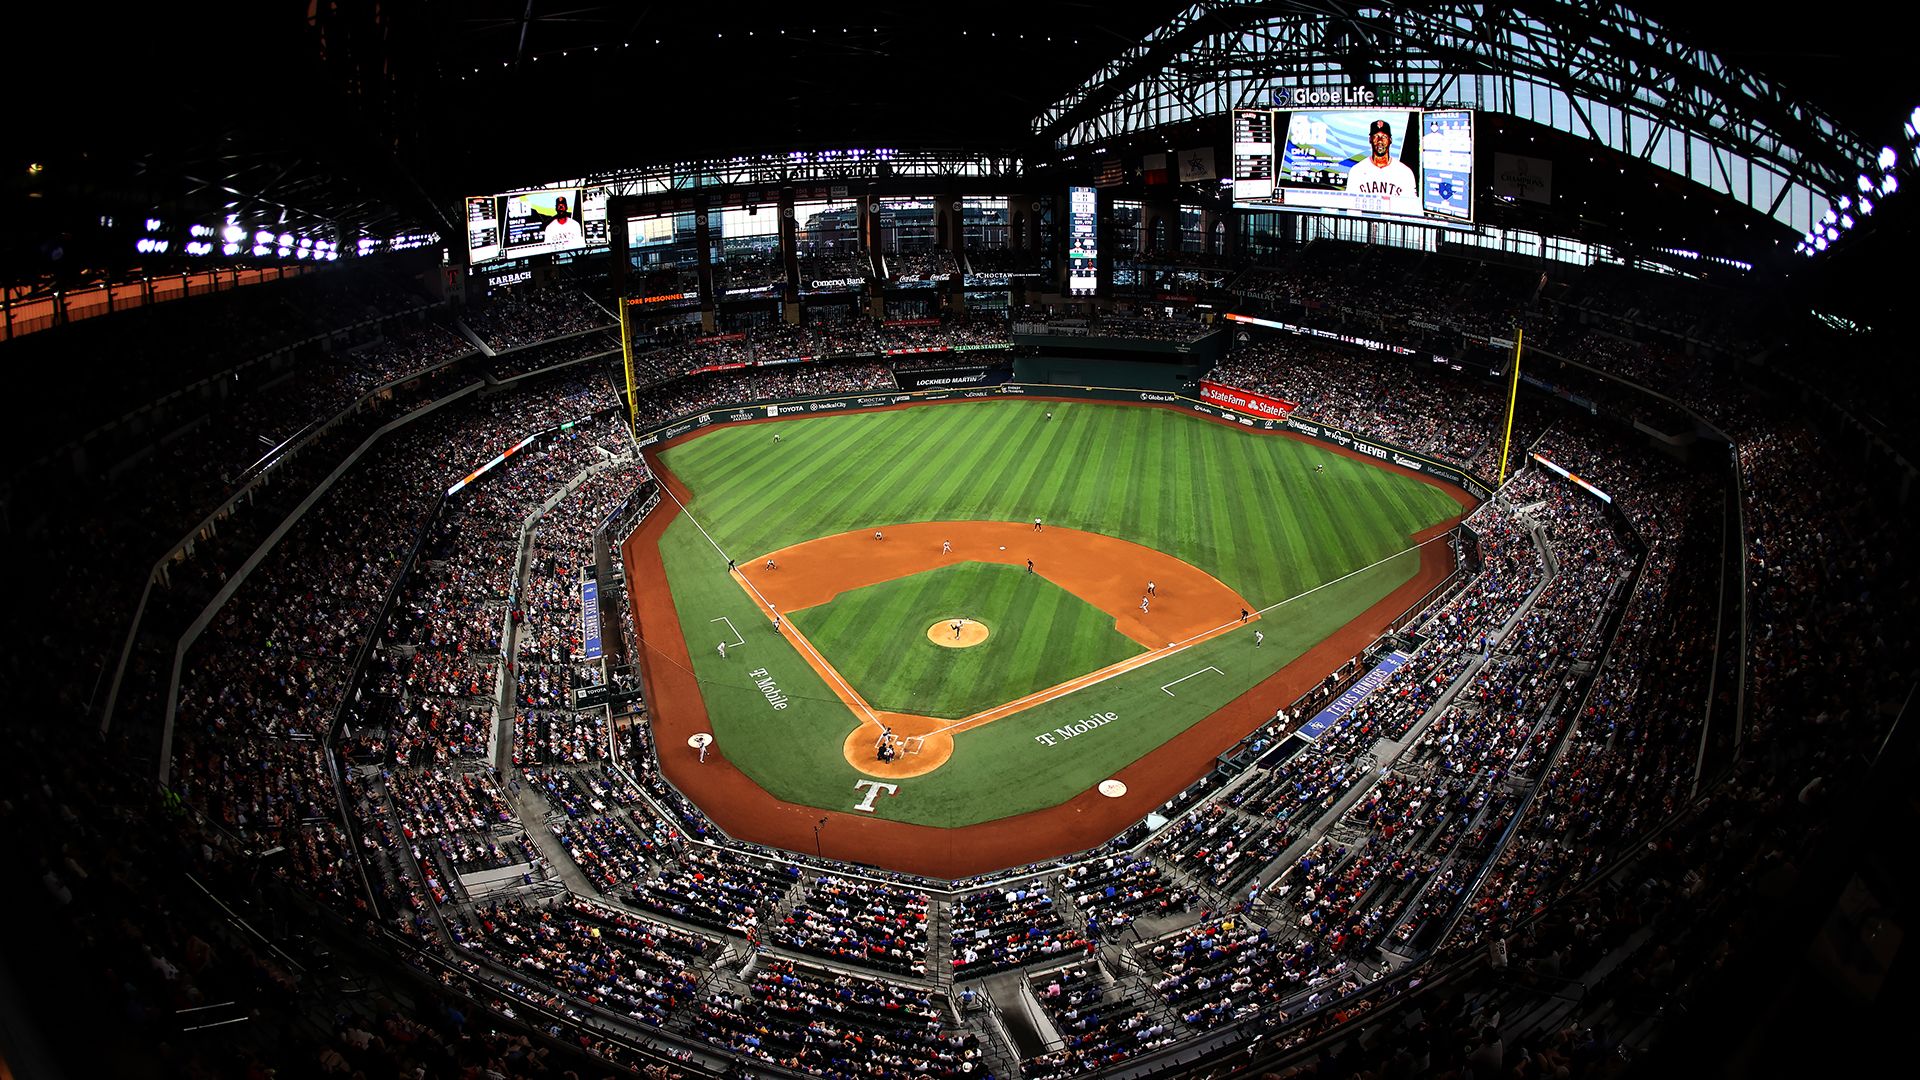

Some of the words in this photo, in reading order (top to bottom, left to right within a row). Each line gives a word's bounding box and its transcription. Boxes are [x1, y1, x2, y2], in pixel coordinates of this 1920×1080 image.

[1294, 87, 1341, 104] Globe
[1344, 85, 1375, 103] Life
[1359, 180, 1403, 197] GIANTS
[488, 270, 532, 287] KARBACH
[847, 276, 866, 286] Bank
[644, 293, 684, 304] PERSONNEL
[981, 343, 1009, 351] STAFFING
[916, 377, 951, 387] LOCKHEED
[951, 375, 977, 385] MARTIN
[1147, 393, 1164, 402] Globe
[778, 404, 804, 414] TOYOTA
[818, 402, 837, 410] Medical
[1258, 401, 1288, 419] StateFa
[1295, 421, 1319, 434] National
[1331, 430, 1351, 446] Kroger
[1353, 441, 1388, 460] 7-ELEVEN
[586, 687, 607, 695] TOYOTA
[754, 676, 788, 711] Mobile
[1326, 692, 1359, 716] TEXAS
[1353, 668, 1388, 700] RANGERS
[1053, 711, 1119, 741] Mobile
[853, 778, 901, 814] T
